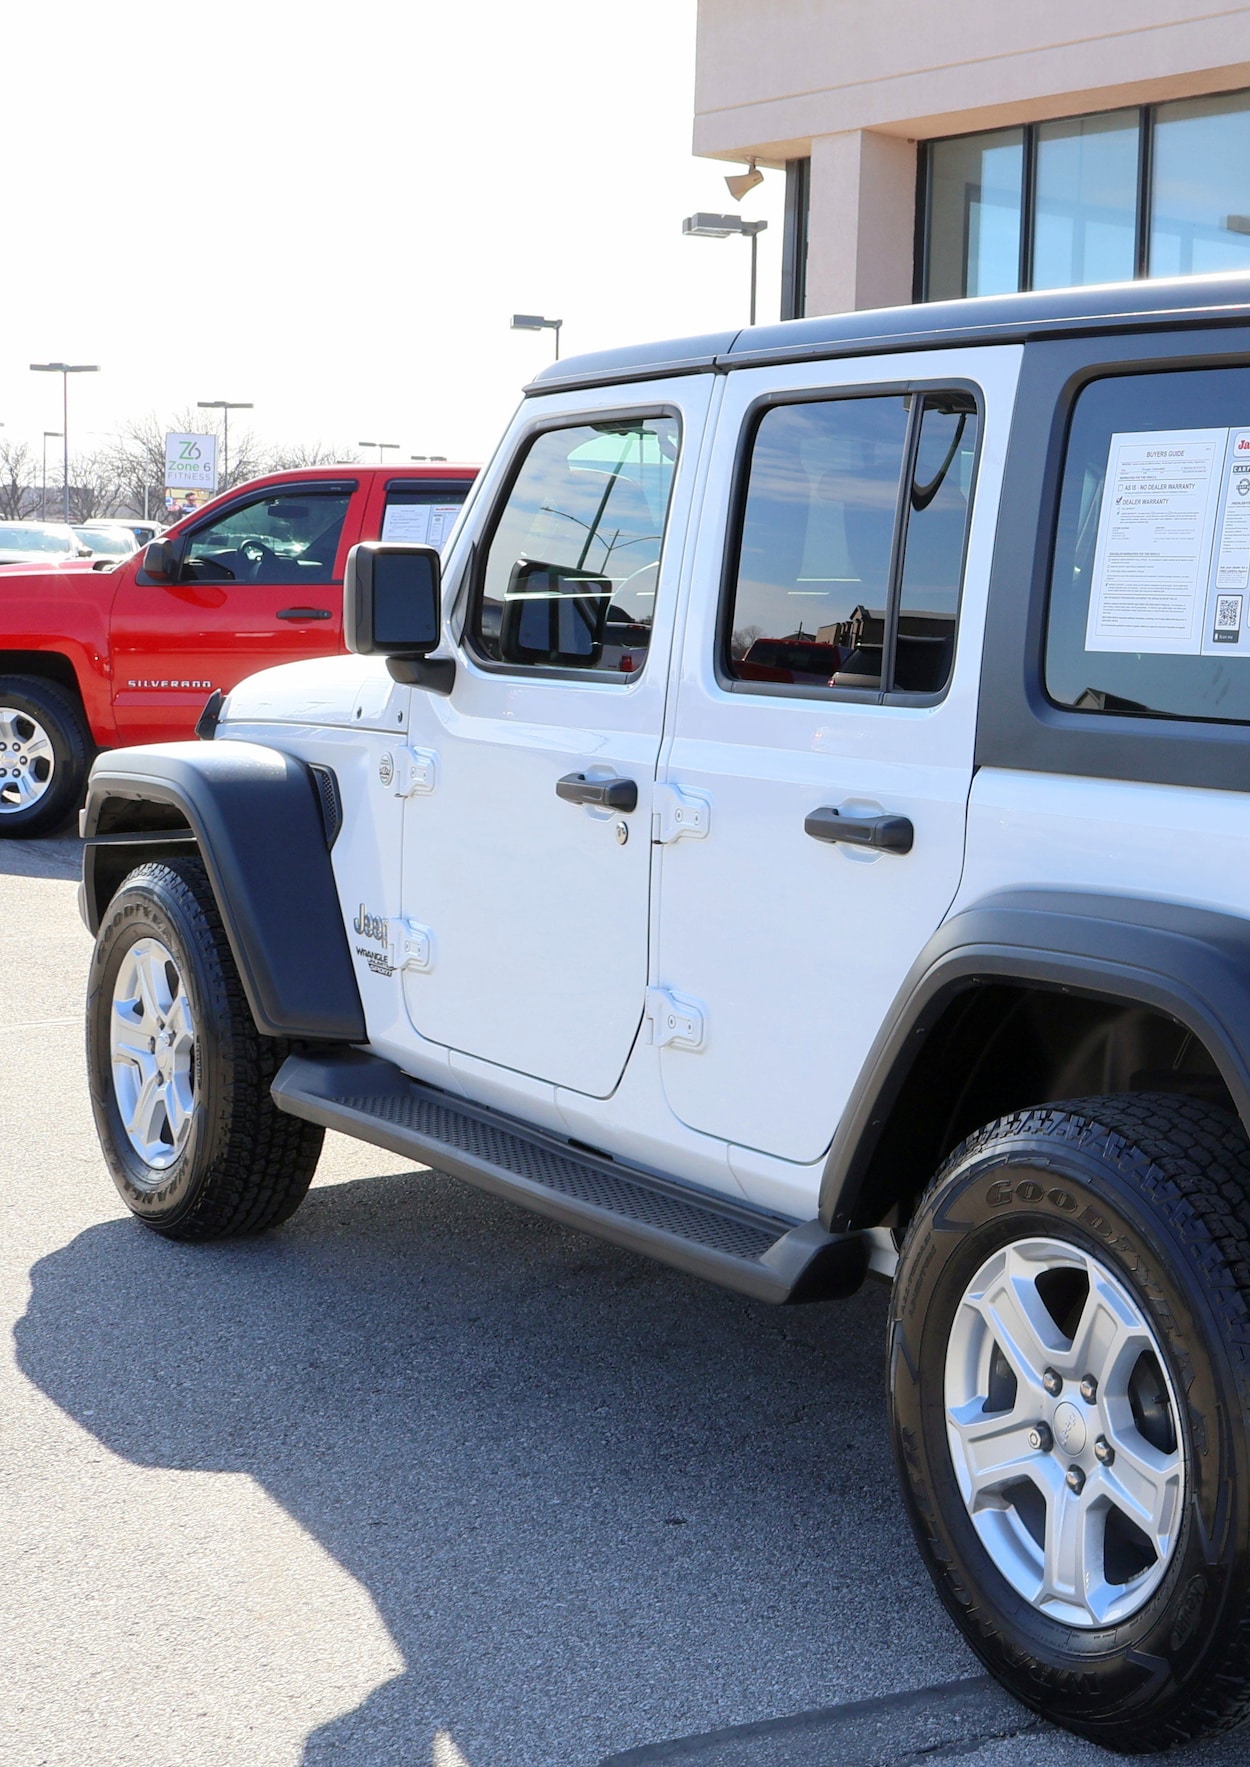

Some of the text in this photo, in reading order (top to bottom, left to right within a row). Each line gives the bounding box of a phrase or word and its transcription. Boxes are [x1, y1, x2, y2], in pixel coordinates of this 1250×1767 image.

[1146, 450, 1168, 458] BUYERS
[168, 460, 211, 472] Zone 6
[167, 471, 211, 481] FITNESS
[127, 680, 212, 688] SILVERADO
[355, 946, 389, 964] WRANGLE
